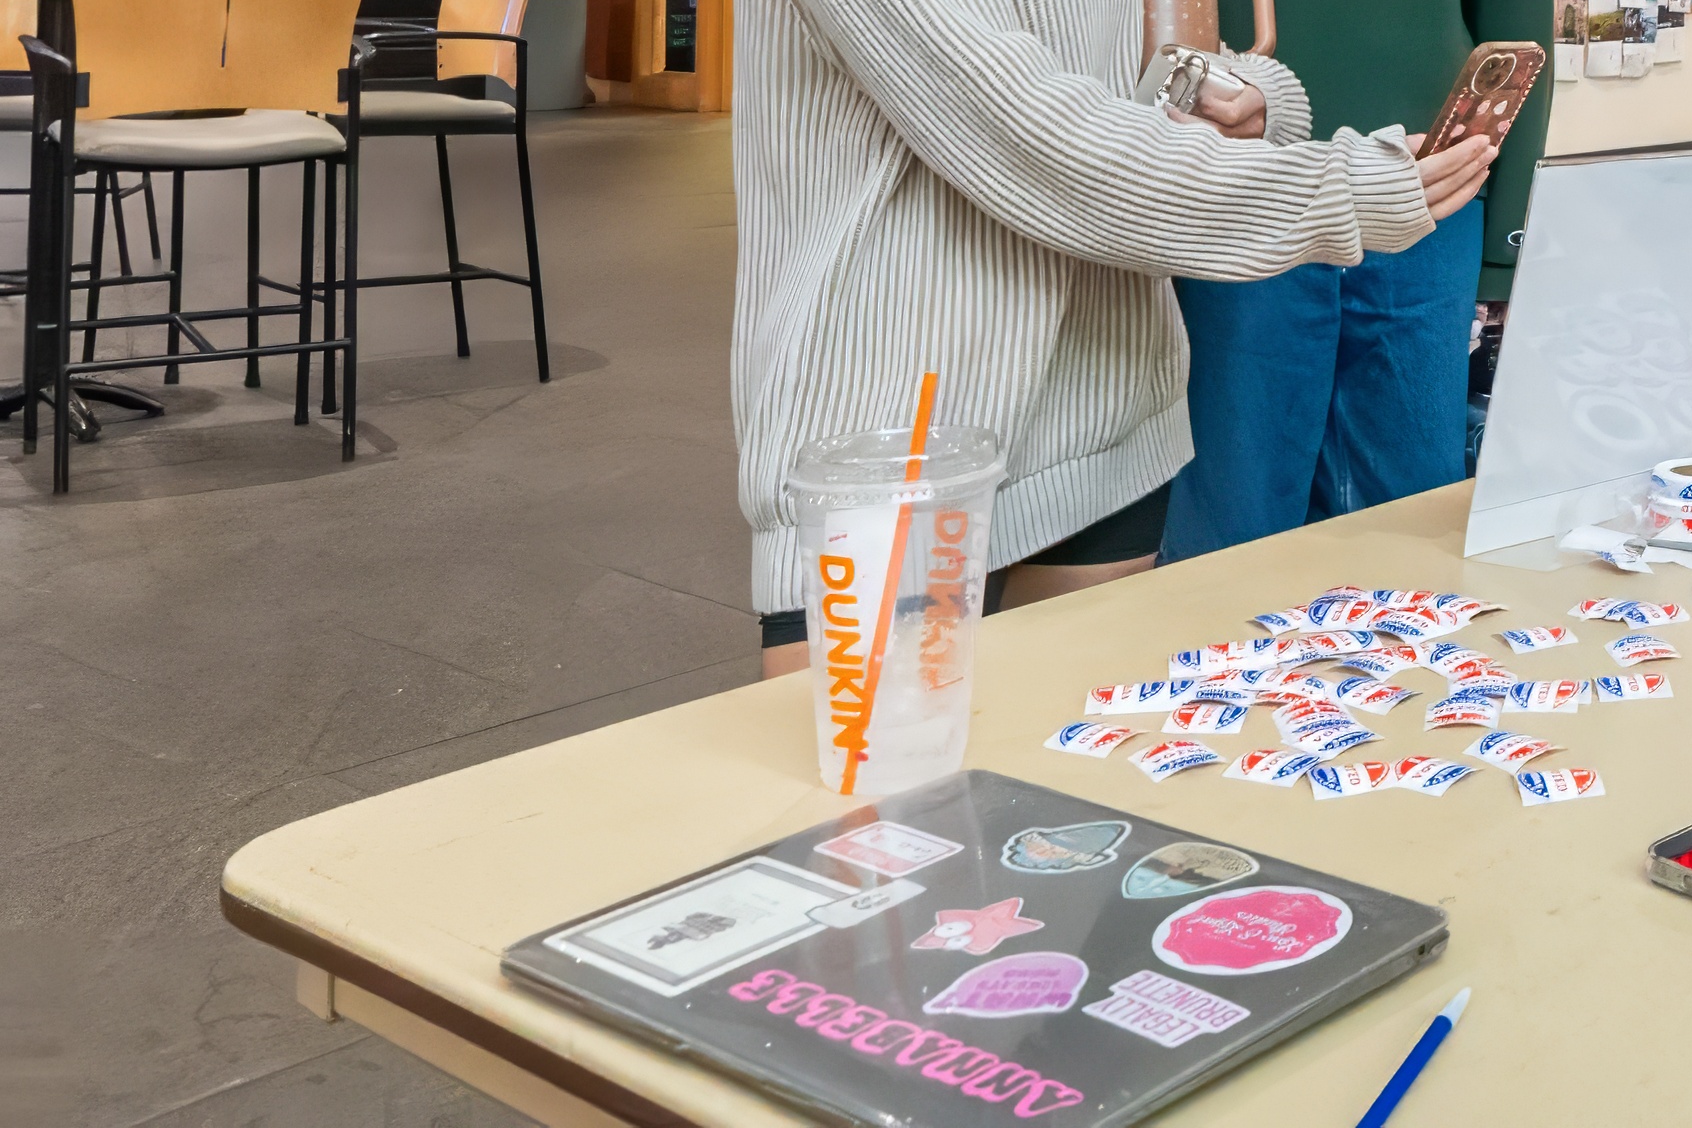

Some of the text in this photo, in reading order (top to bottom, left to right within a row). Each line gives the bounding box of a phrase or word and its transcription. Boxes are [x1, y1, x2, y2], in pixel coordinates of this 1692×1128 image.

[1094, 995, 1200, 1043] LEGALLY
[1118, 972, 1244, 1029] BRUNETTE
[726, 969, 1086, 1119] ANNABELLE
